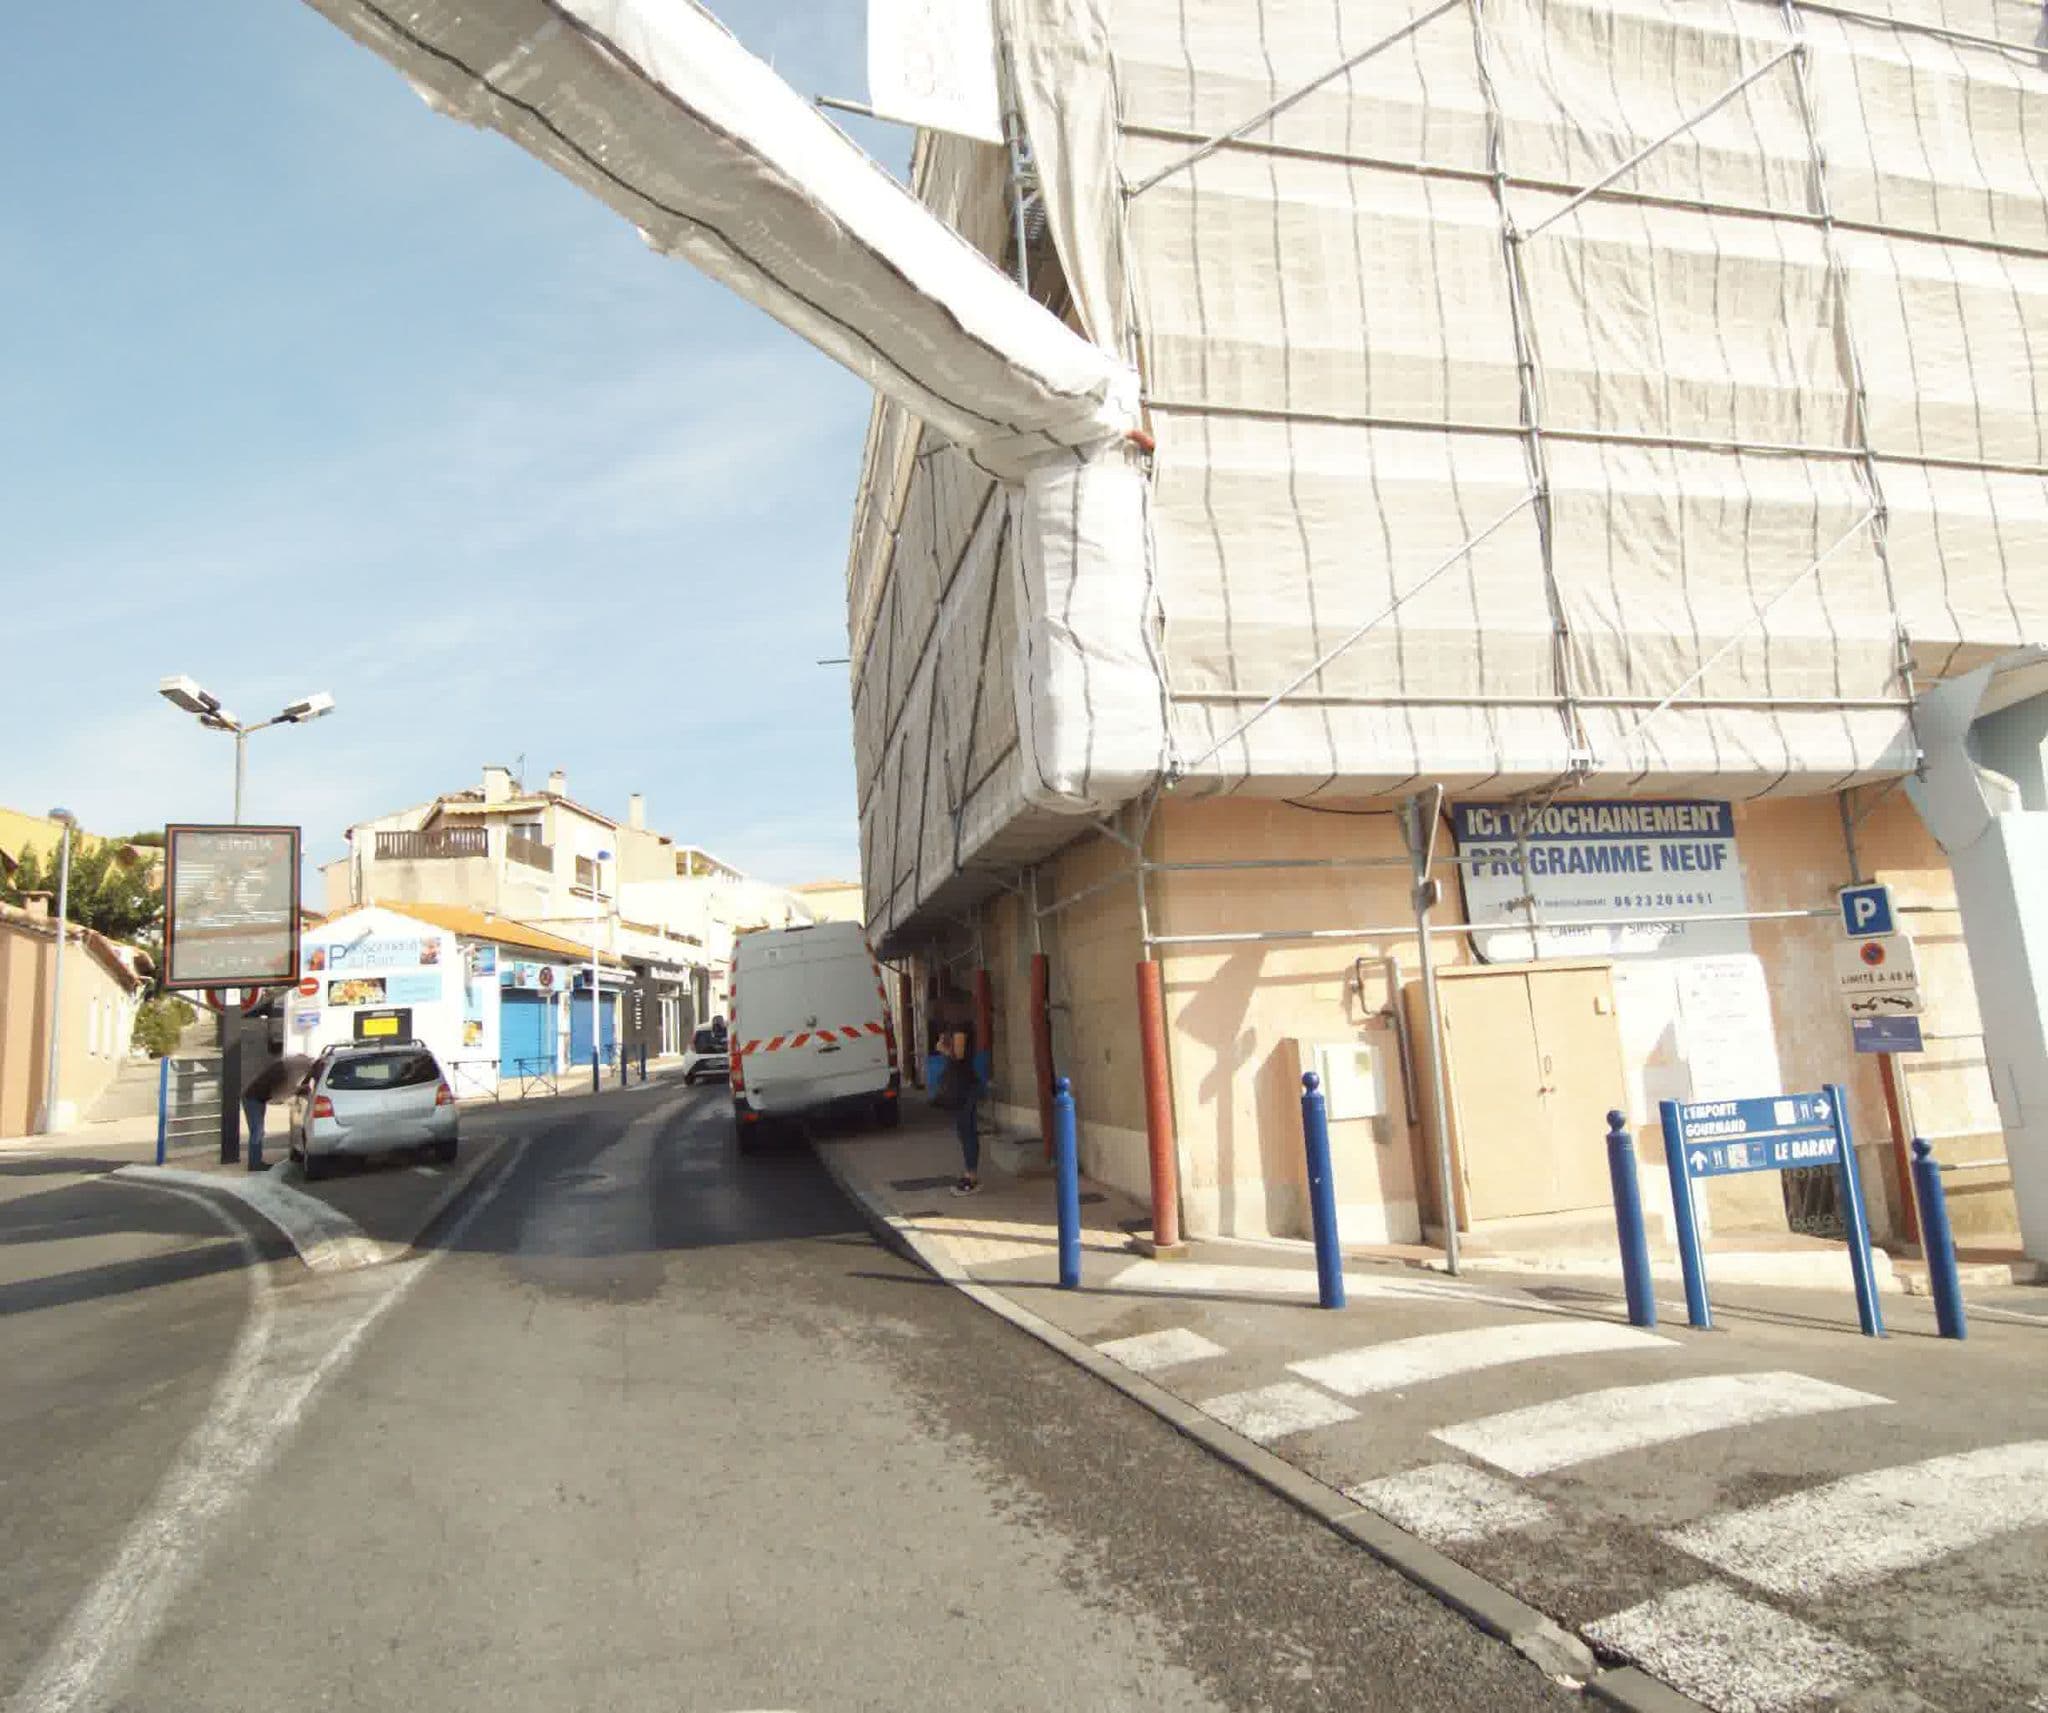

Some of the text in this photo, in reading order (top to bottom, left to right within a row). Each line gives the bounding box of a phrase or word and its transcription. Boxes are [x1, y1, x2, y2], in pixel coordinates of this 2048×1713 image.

[1465, 808, 1502, 835] ICI
[1470, 843, 1727, 877] PROGRAMME NEUF
[1853, 896, 1877, 929] P
[1774, 1142, 1788, 1161] LE
